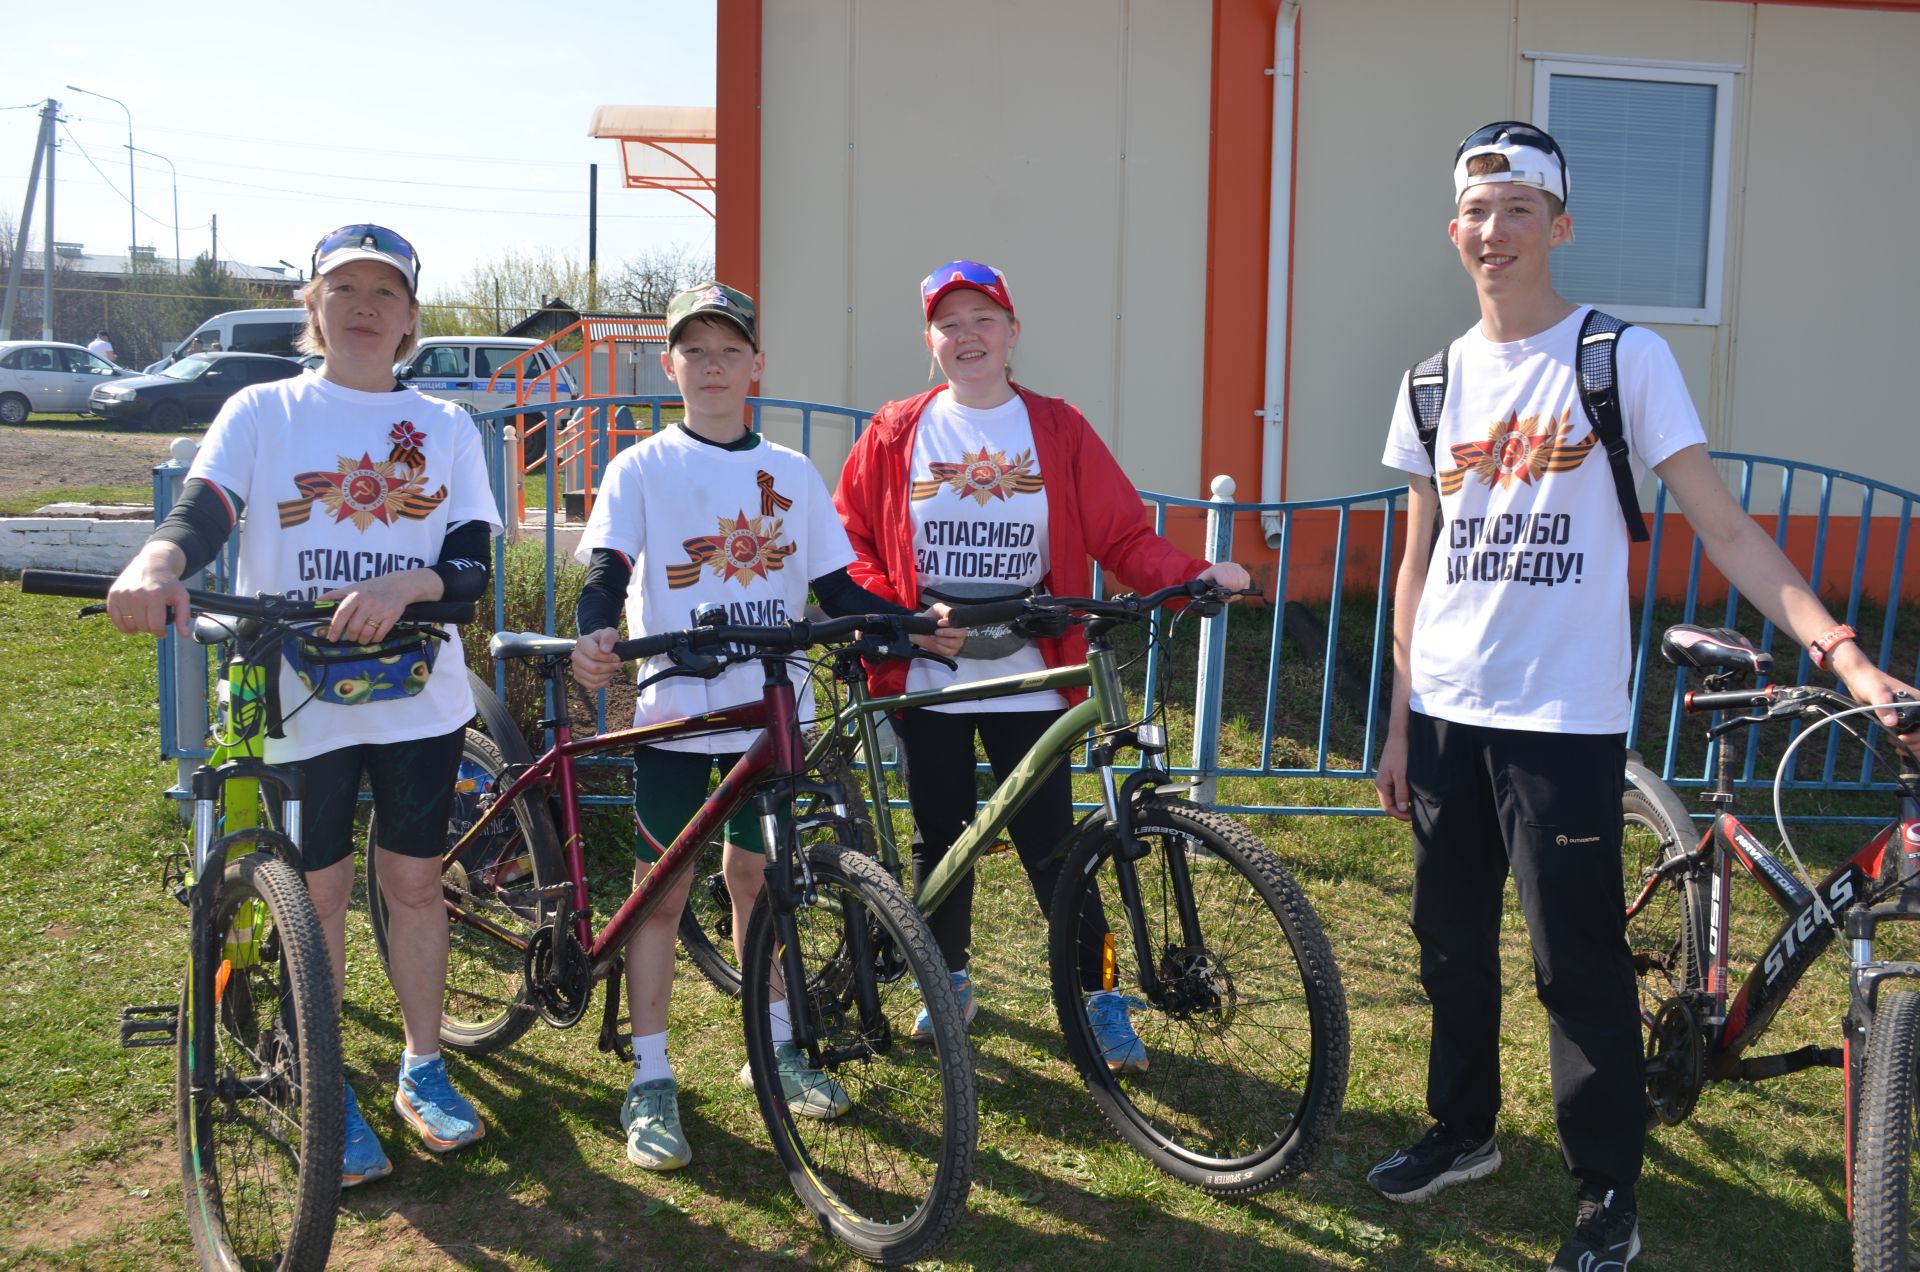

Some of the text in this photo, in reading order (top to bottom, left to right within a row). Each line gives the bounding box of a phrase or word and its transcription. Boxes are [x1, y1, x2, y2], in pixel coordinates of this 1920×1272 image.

[924, 520, 1035, 548] СПАСИБО
[915, 549, 1038, 580] ЗА ПОБЕДУ!
[1735, 834, 1798, 896] NAVIGATOR
[1764, 869, 1854, 987] STELS
